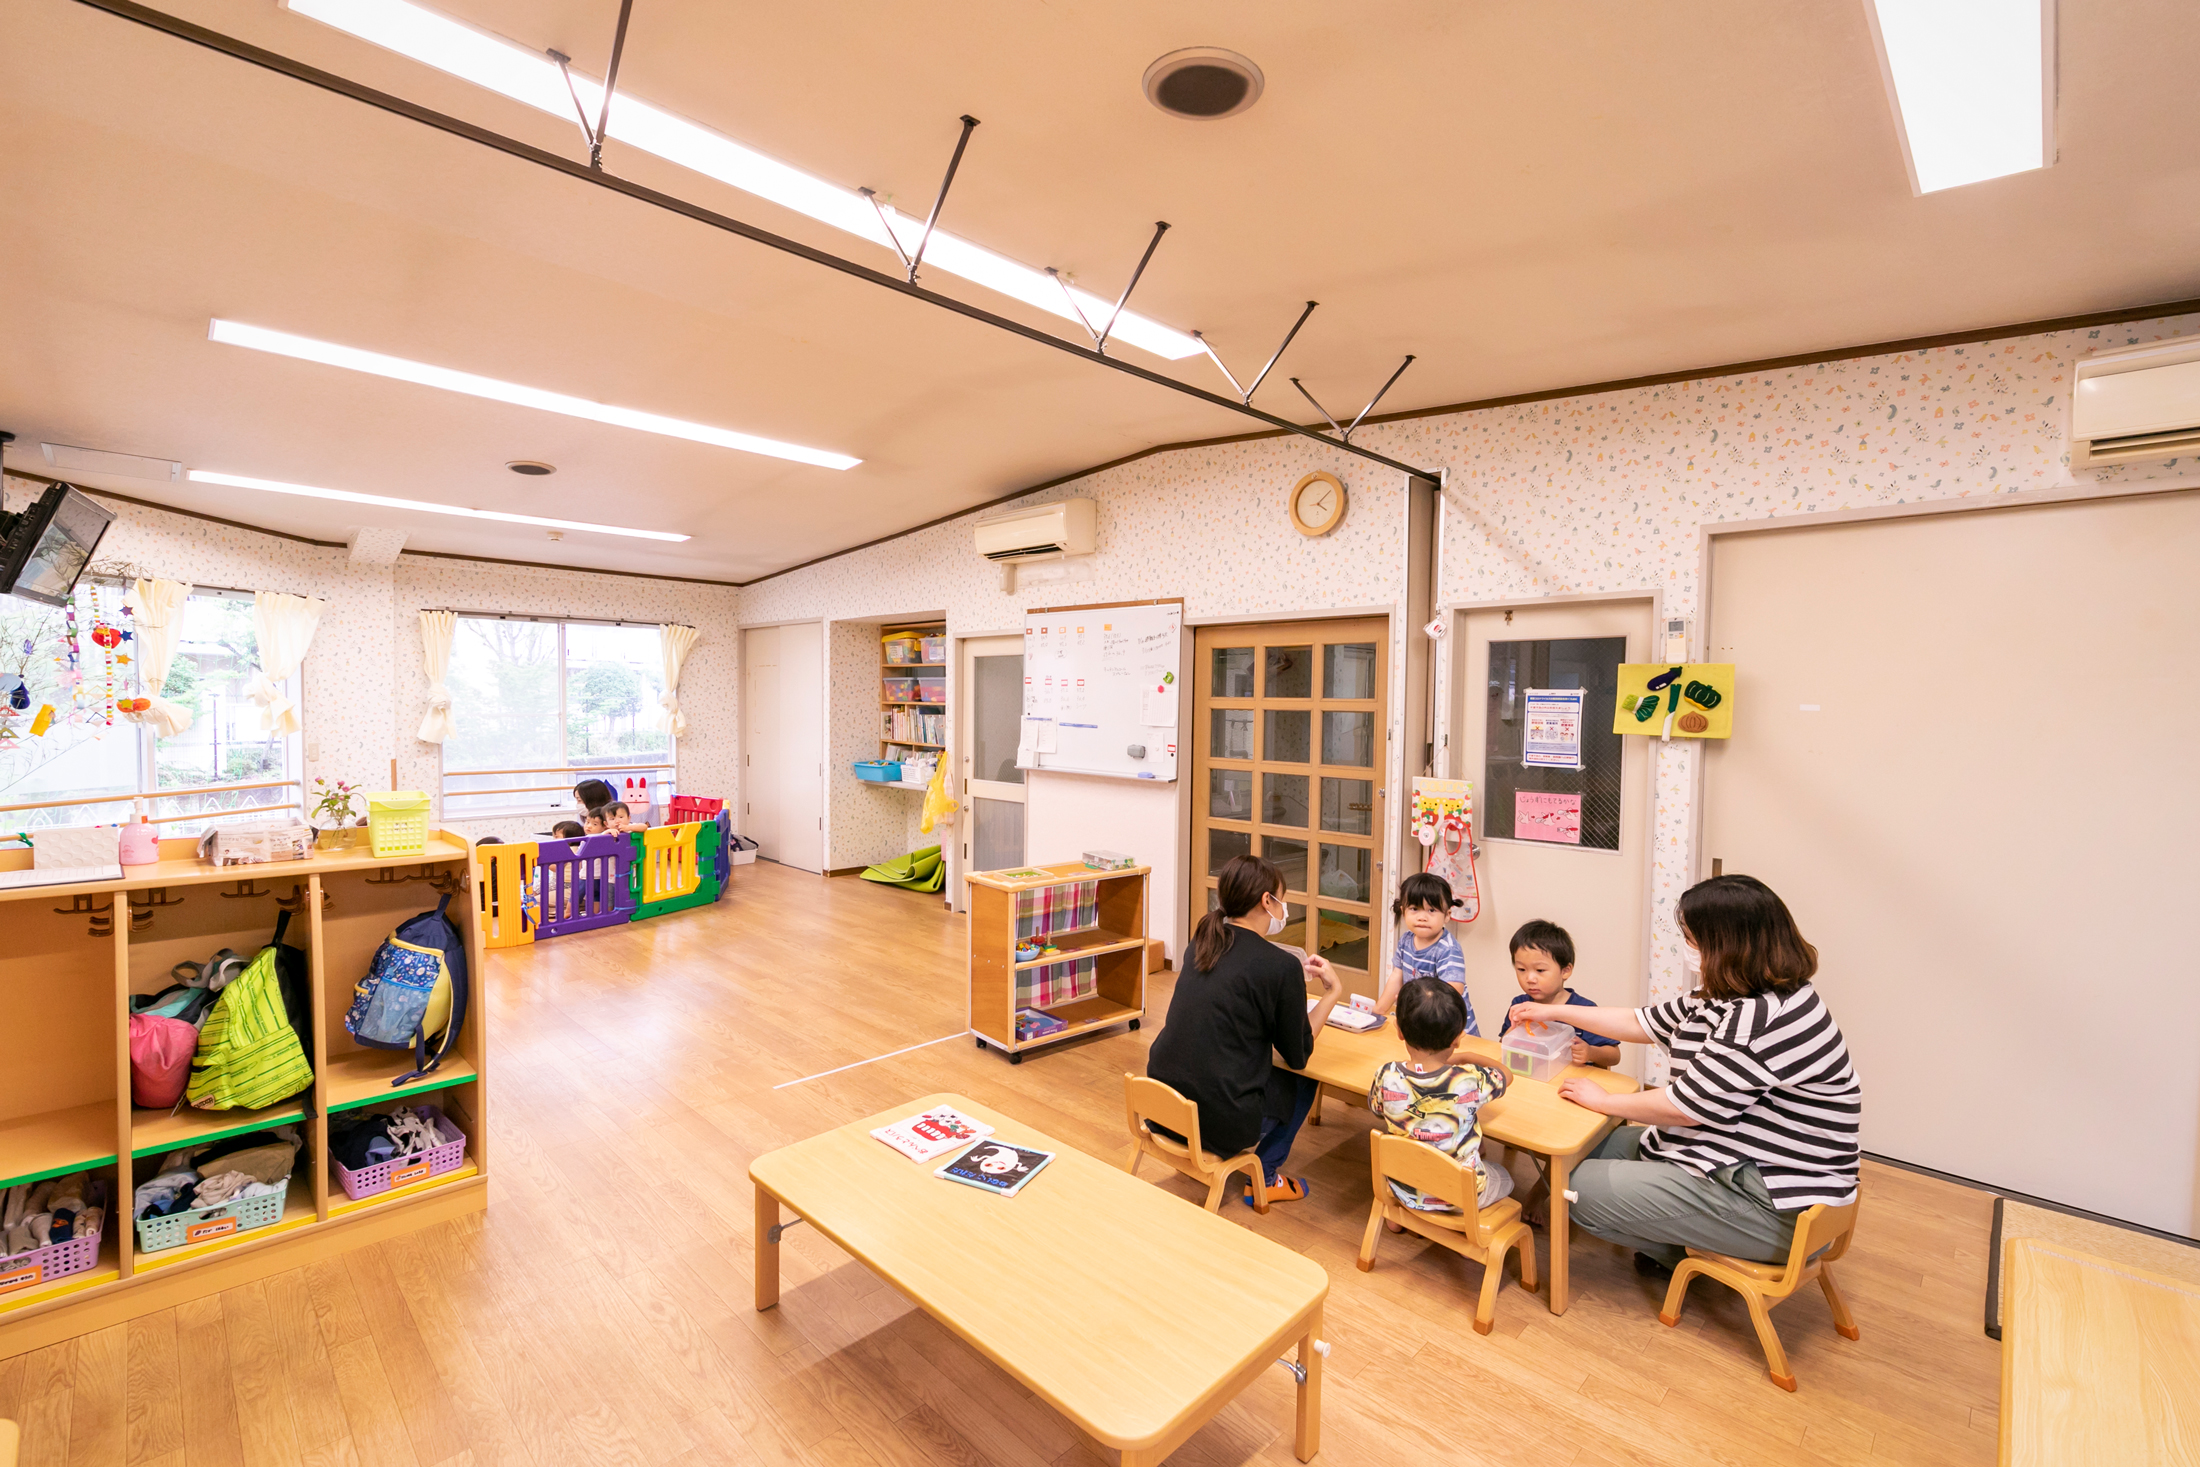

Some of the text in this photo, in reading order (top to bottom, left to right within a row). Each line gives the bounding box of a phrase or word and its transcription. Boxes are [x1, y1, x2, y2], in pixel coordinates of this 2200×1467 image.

[1421, 780, 1463, 791] おとうばん
[1519, 795, 1577, 806] じょうずにもてるかな
